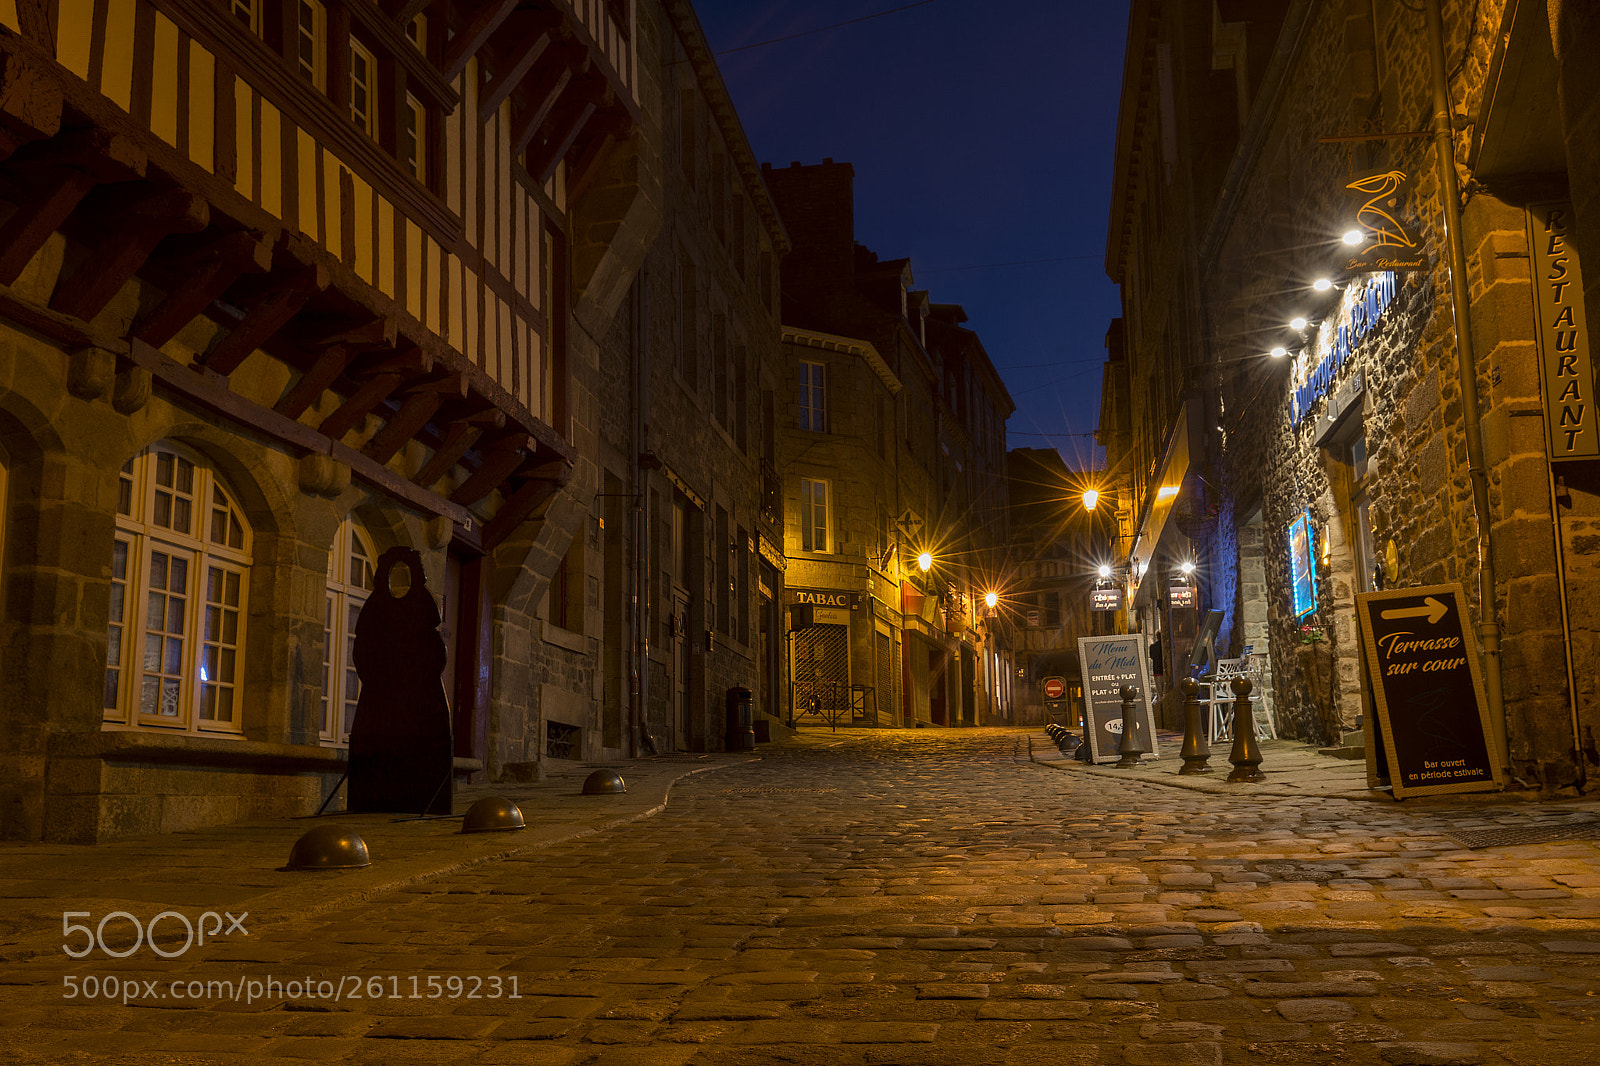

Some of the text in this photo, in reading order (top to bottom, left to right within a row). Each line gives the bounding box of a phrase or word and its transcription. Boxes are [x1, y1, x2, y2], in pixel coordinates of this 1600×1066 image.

[1345, 258, 1367, 270] Bar
[1376, 257, 1423, 269] Restaurant
[1544, 208, 1586, 452] RESTAURANT
[796, 591, 847, 607] TABAC
[1092, 642, 1128, 656] Menu
[1378, 631, 1461, 660] Terrasse
[1088, 655, 1136, 670] du Midi
[1386, 656, 1467, 676] sur cour
[1424, 759, 1466, 769] Bar ouvert
[1421, 771, 1452, 780] période
[1453, 768, 1484, 776] estivale
